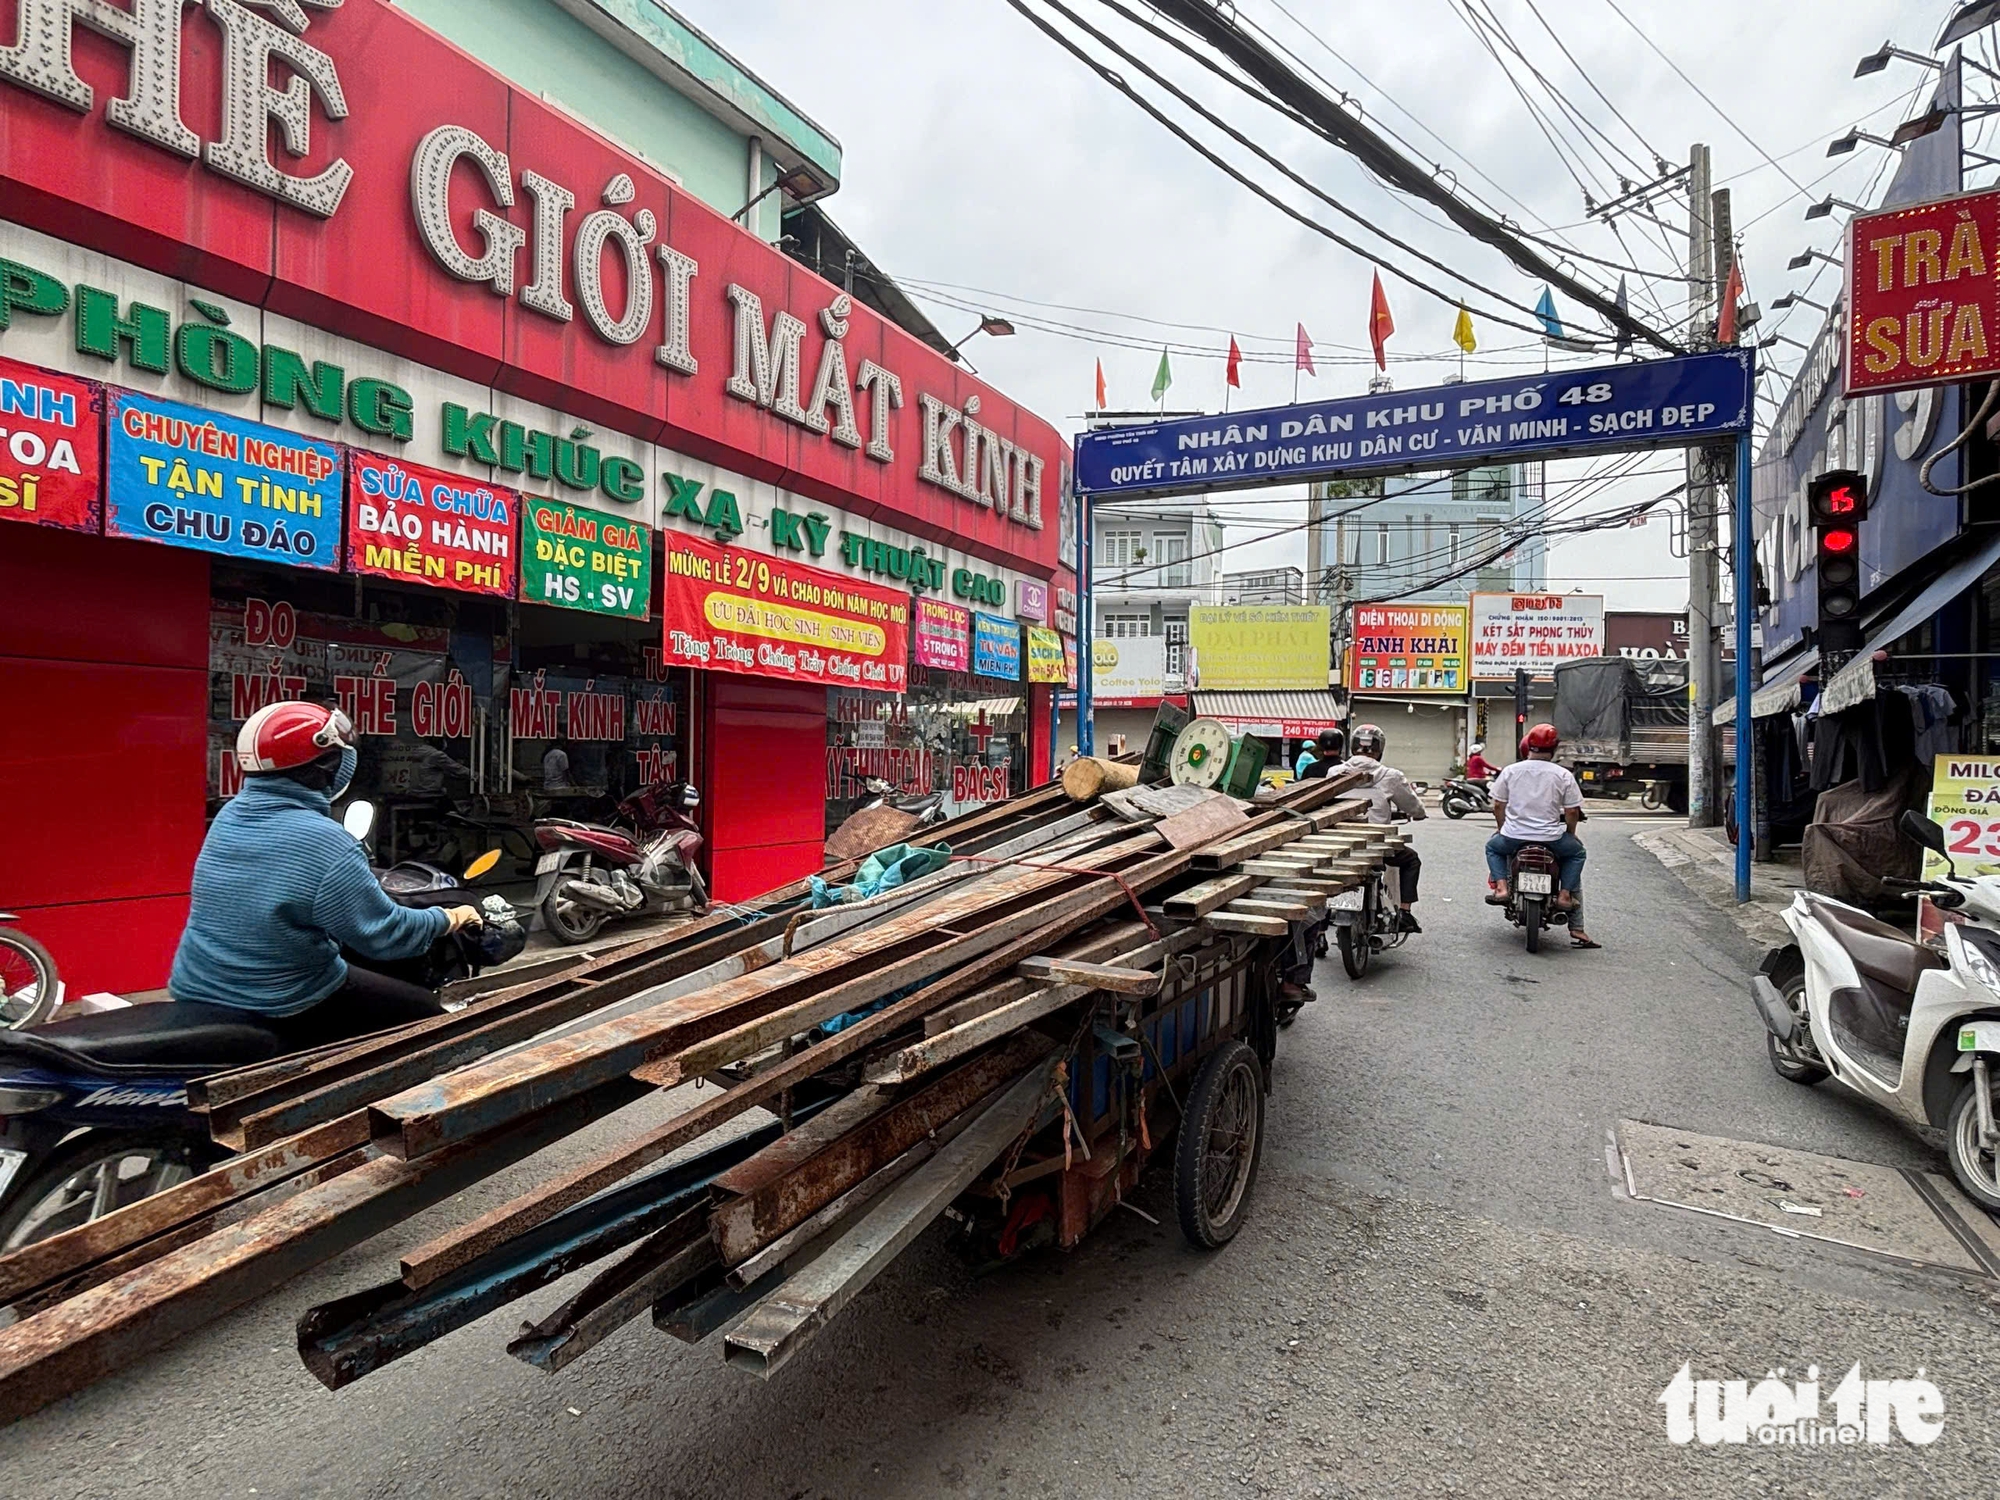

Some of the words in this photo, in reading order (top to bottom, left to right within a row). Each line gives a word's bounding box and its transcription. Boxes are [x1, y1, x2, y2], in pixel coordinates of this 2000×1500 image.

[1869, 209, 1987, 292] TRÀ
[411, 124, 698, 376] GIỚI
[726, 283, 904, 464] MẮT
[918, 392, 1045, 531] KÍNH
[1864, 299, 1989, 374] SỮA
[1179, 425, 1269, 450] NHÂN
[1280, 414, 1353, 438] DÂN
[1366, 401, 1444, 429] KHU
[1460, 383, 1548, 417] PHỐ
[1559, 383, 1613, 405] 48
[123, 407, 239, 461] CHUYÊN
[244, 437, 334, 485] NGHIỆP
[1110, 459, 1165, 484] QUYẾT
[1170, 456, 1208, 477] TÂM
[1213, 451, 1248, 473] XÂY
[1254, 446, 1307, 471] DỰNG
[1311, 442, 1353, 463] KHU
[1360, 434, 1402, 457] DÂN
[1408, 427, 1439, 451] CƯ
[1457, 424, 1501, 446] VĂN
[1509, 418, 1567, 441] MINH
[1588, 409, 1652, 435] SẠCH
[1661, 403, 1715, 429] ĐẸP
[139, 456, 223, 499] TẬN
[236, 475, 323, 518] TÌNH
[360, 465, 425, 506] SỬA
[431, 484, 509, 525] CHỮA
[442, 401, 645, 502] KHÚC
[662, 472, 743, 543] XẠ
[772, 508, 832, 556] KỸ
[840, 530, 946, 594] THUẬT
[953, 568, 1006, 607] CAO
[145, 502, 231, 543] CHU
[242, 519, 317, 556] ĐÁO
[358, 502, 422, 540] BẢO
[431, 519, 509, 558] HÀNH
[536, 506, 597, 543] GIẢM
[602, 521, 642, 551] GIÁ
[365, 542, 446, 578] MIỄN
[455, 560, 501, 588] PHÍ
[536, 538, 586, 571] ĐẶC
[592, 550, 642, 582] BIỆT
[544, 573, 580, 602] HS
[601, 587, 634, 610] SV
[669, 548, 711, 579] MỪNG
[714, 554, 732, 585] LỄ
[735, 557, 770, 593] 2/9
[773, 573, 788, 598] VÀ
[791, 576, 821, 606] CHÀO
[823, 586, 844, 611] ĐÓN
[846, 592, 868, 616] NĂM
[870, 600, 888, 623] HỌC
[890, 604, 907, 625] MỚI
[244, 597, 296, 648] ĐO
[712, 600, 732, 622] ƯU
[764, 614, 791, 631] HỌC
[794, 620, 821, 637] SINH
[831, 627, 855, 643] SINH
[858, 629, 882, 648] VIÊN
[1360, 608, 1385, 630] ĐIỆN
[1421, 613, 1431, 626] DI
[1483, 622, 1502, 637] KÉT
[1507, 621, 1525, 637] SẮT
[1529, 627, 1563, 638] PHONG
[670, 630, 709, 660] Tặng
[714, 636, 754, 667] Tròng
[757, 642, 796, 672] Chống
[828, 658, 860, 681] Chống
[1092, 653, 1117, 666] OLO
[1475, 639, 1498, 656] MÁY
[1501, 638, 1525, 656] ĐẾM
[1557, 643, 1599, 657] MAXDA
[334, 652, 397, 735] THẾ
[411, 668, 472, 738] GIỚI
[510, 668, 561, 739] MẮT
[567, 680, 625, 741] KÍNH
[636, 688, 677, 736] VẤN
[1284, 725, 1301, 735] 240
[902, 748, 932, 797] CAO
[953, 755, 991, 804] BÁC
[991, 756, 1011, 801] SĨ
